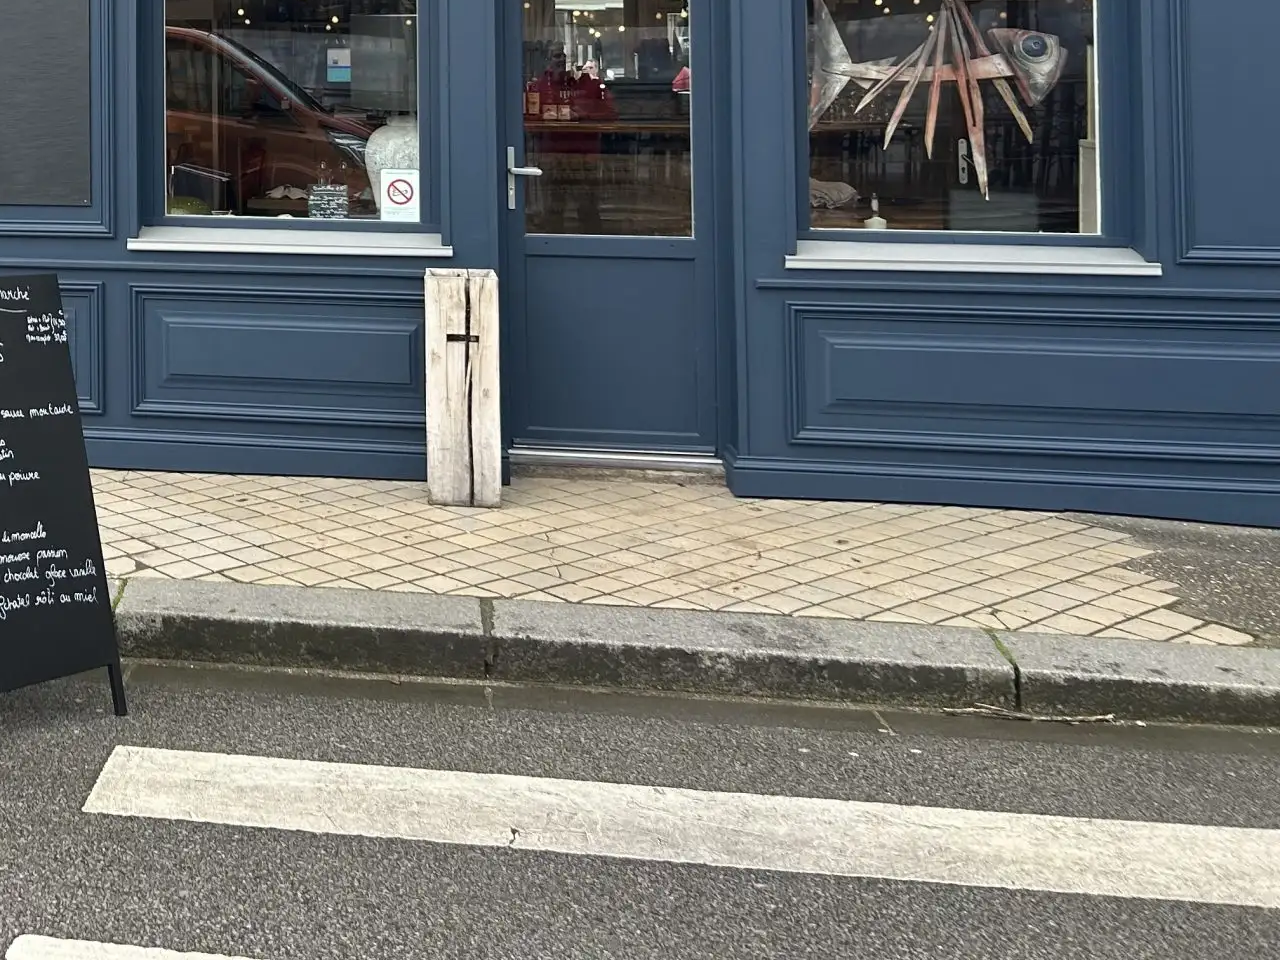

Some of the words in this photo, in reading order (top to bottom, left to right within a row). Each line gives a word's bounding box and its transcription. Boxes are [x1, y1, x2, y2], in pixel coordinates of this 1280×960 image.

[29, 403, 74, 419] moutarde
[8, 469, 40, 487] poivre
[1, 520, 47, 543] limoncello
[36, 544, 68, 567] passion
[3, 565, 39, 583] chocolat
[45, 563, 67, 587] glace
[69, 558, 97, 578] vanille
[34, 587, 55, 606] rôti
[59, 594, 71, 604] au
[74, 586, 99, 605] miel
